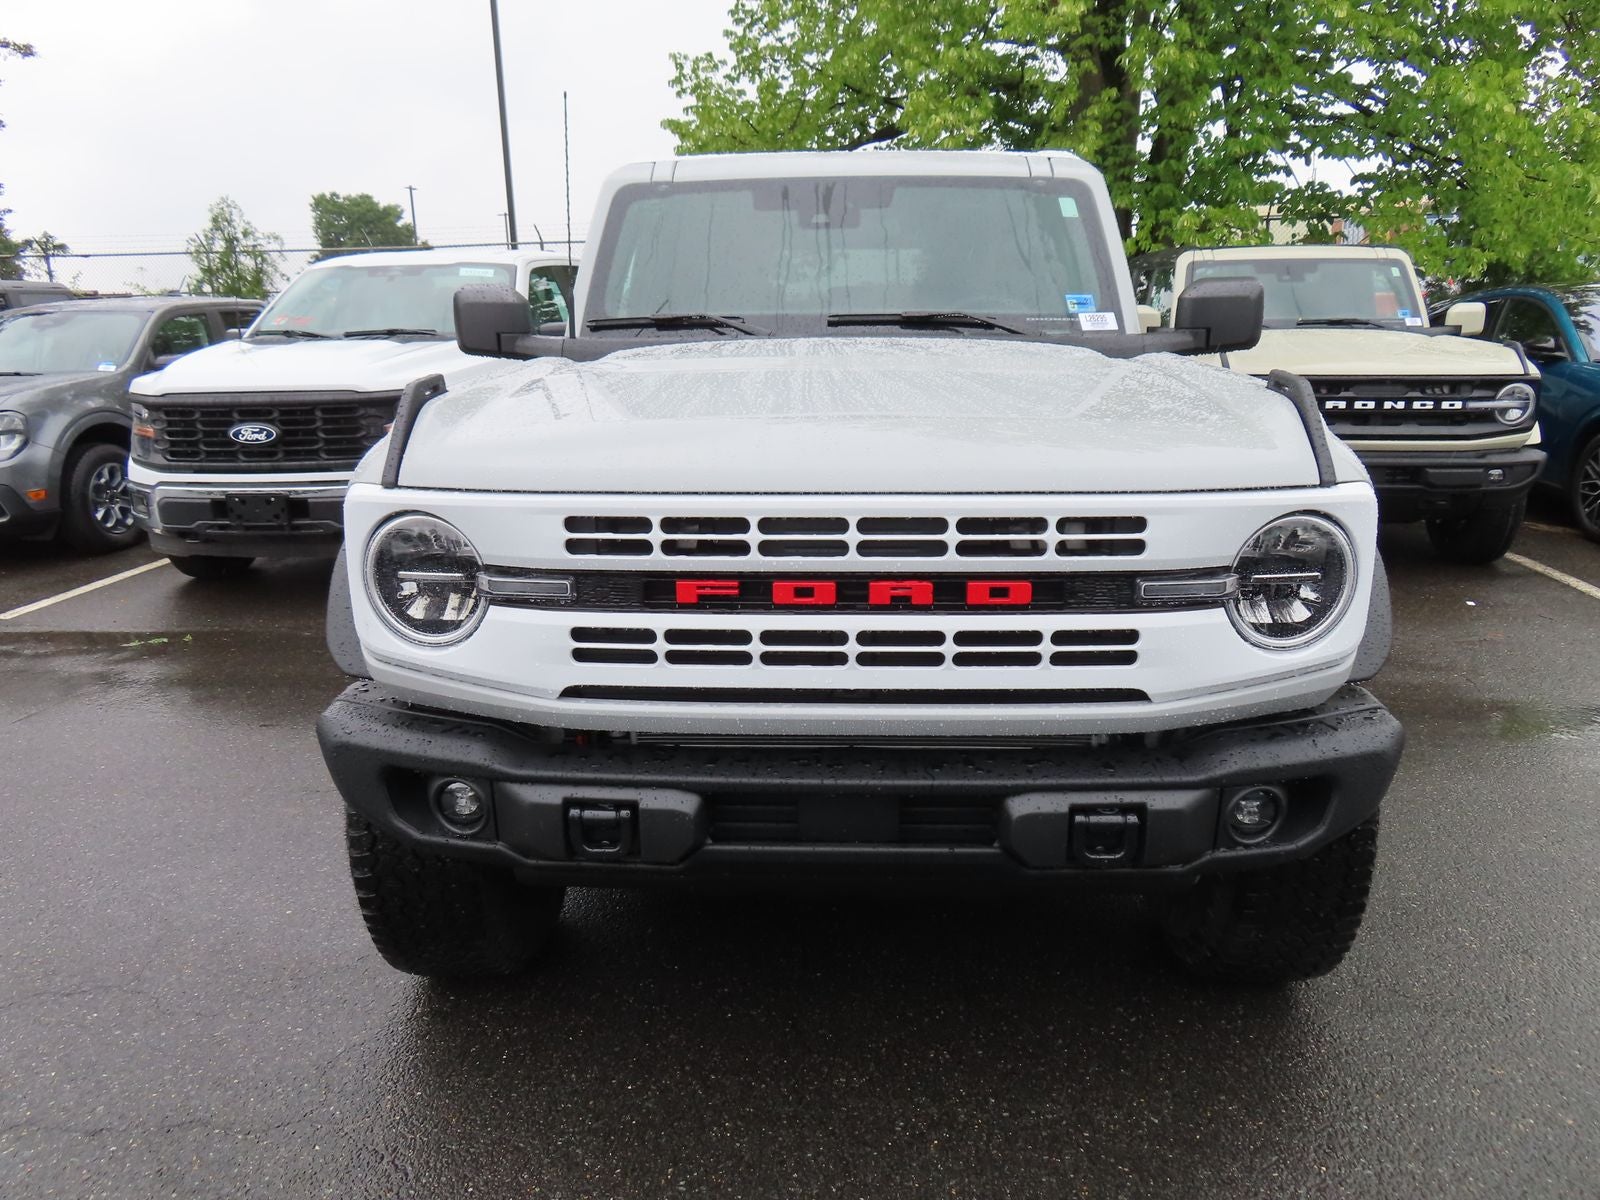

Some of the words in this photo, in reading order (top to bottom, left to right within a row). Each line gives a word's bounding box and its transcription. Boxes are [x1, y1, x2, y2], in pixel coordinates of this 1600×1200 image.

[1325, 401, 1463, 410] RONCO
[239, 428, 267, 441] Ford
[676, 580, 1032, 605] FORD
